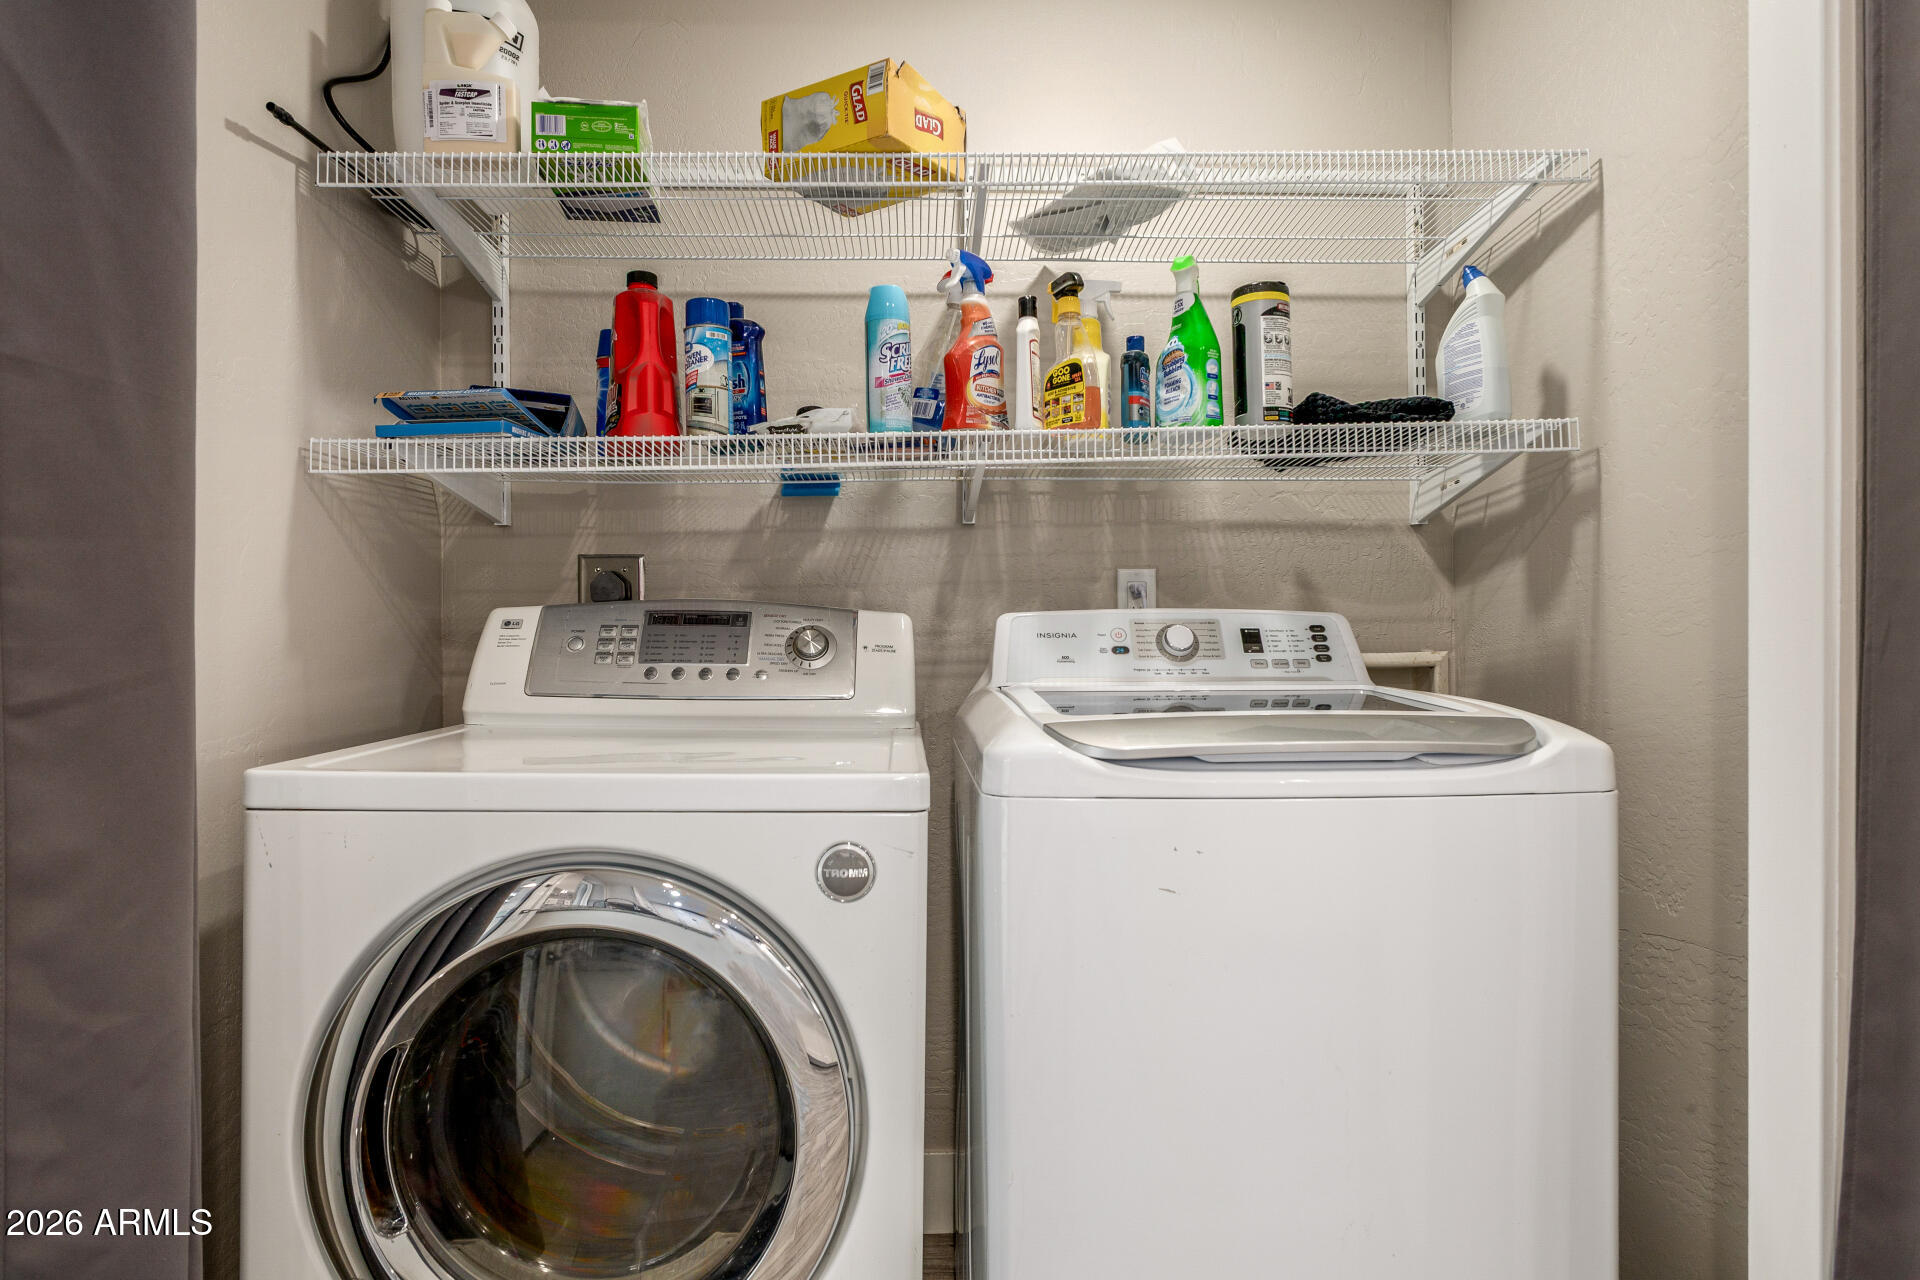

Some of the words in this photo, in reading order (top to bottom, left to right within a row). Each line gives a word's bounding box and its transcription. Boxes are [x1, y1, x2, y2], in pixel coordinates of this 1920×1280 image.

[851, 85, 865, 122] GLAD
[916, 114, 942, 136] GLAD
[974, 349, 999, 371] Lysol
[1052, 366, 1070, 376] GOO
[1052, 374, 1070, 384] GONE
[823, 867, 868, 878] TROMM
